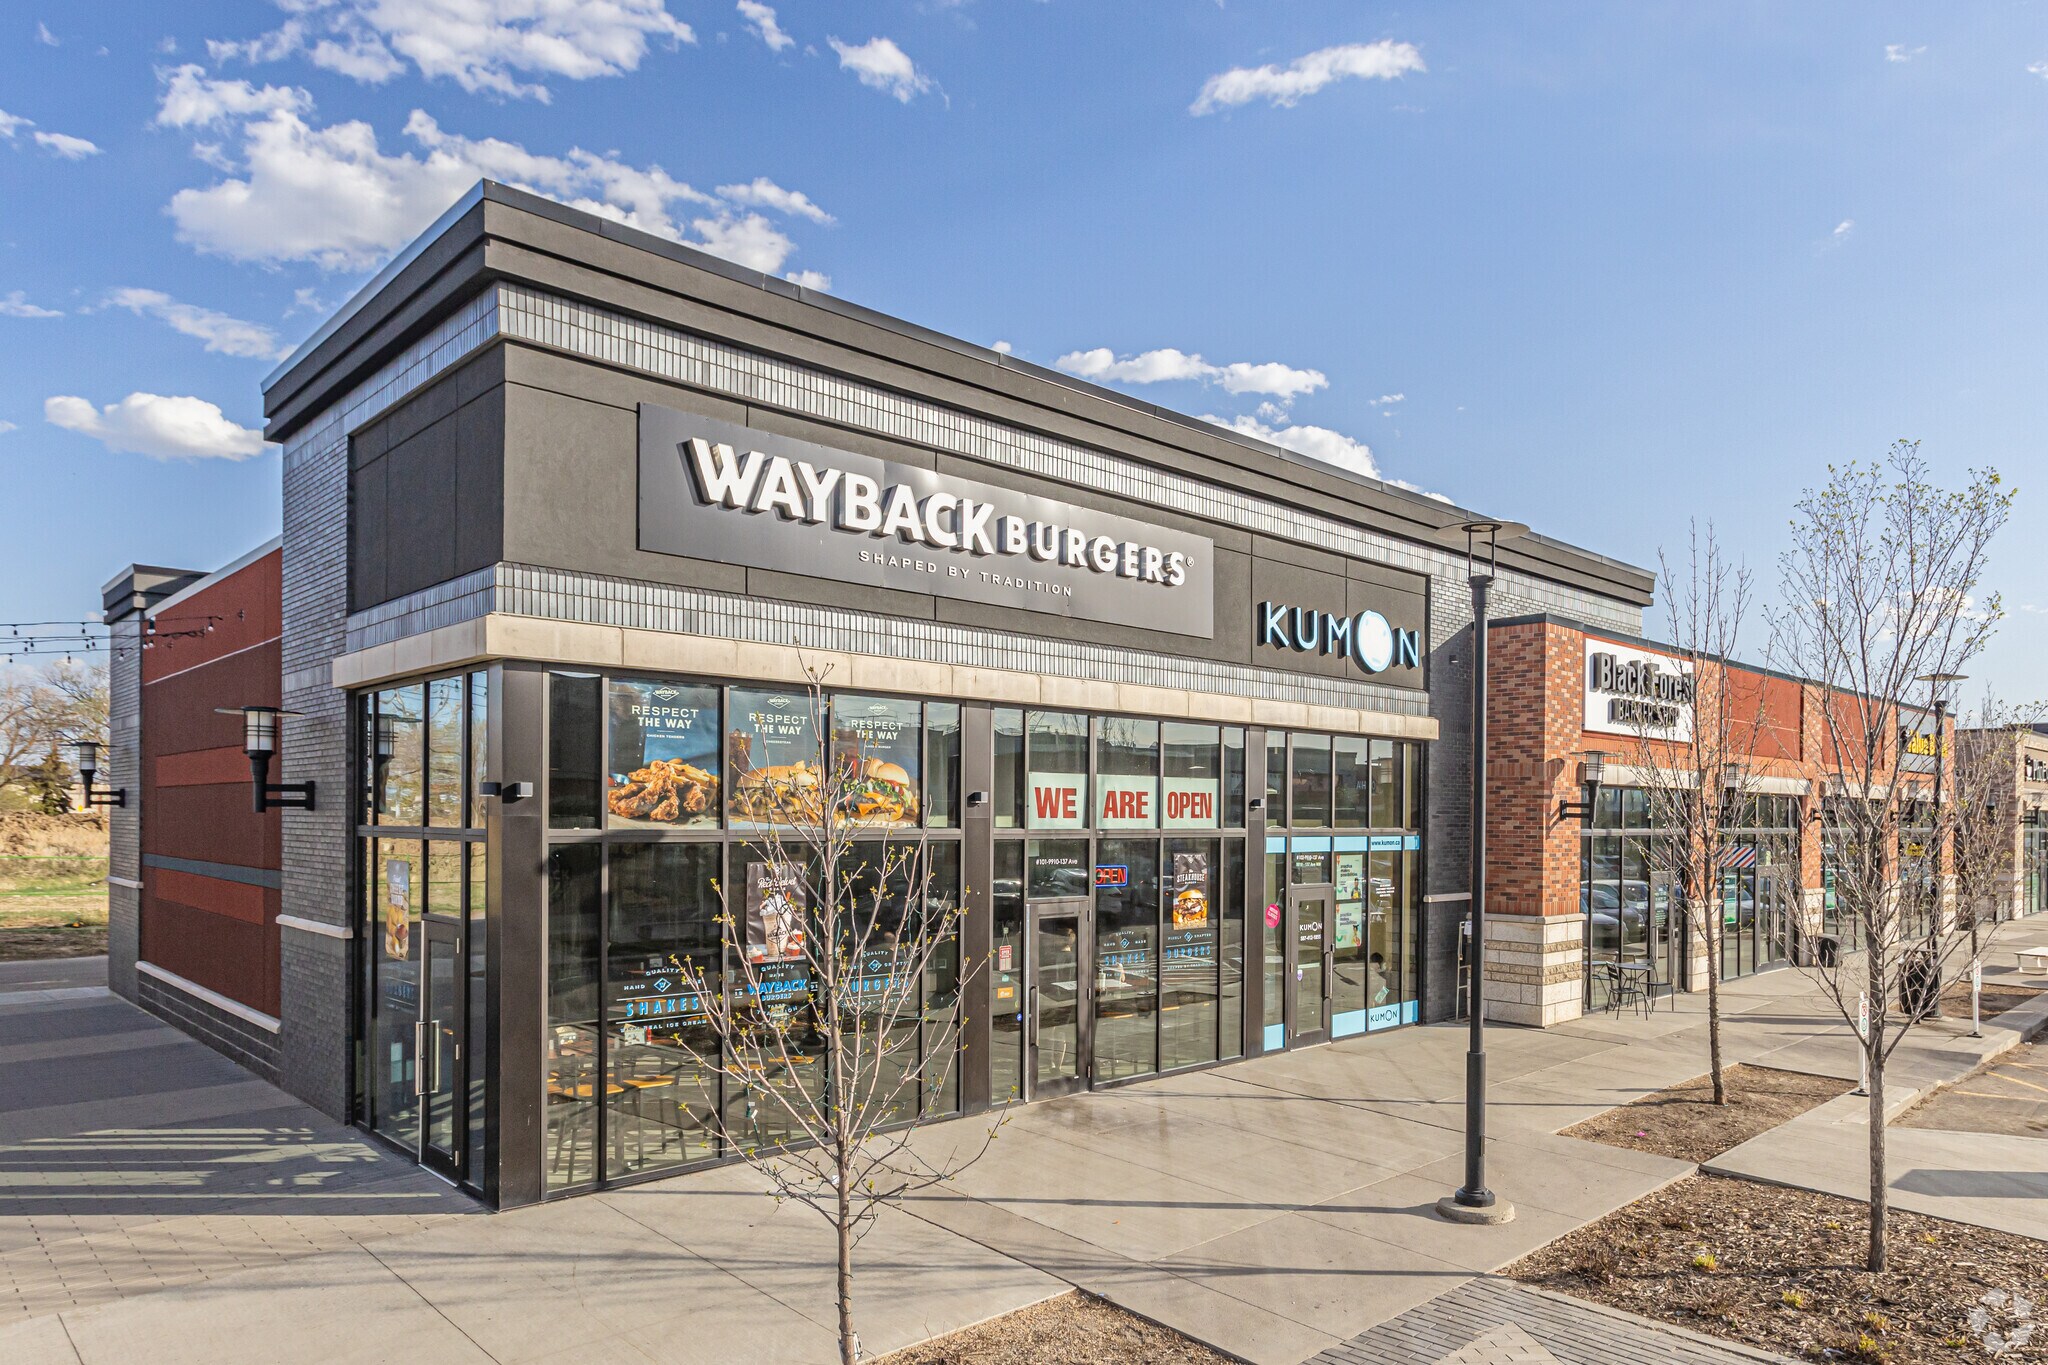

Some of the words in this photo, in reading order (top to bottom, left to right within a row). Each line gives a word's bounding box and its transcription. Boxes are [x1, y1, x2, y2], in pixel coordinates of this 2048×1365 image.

[679, 437, 995, 556] WAYBACK
[859, 550, 937, 573] SHAPED
[948, 566, 970, 579] BY
[980, 571, 1072, 597] TRADITION
[1257, 600, 1420, 675] KUMON
[1593, 652, 1647, 698] Black
[631, 704, 699, 718] RESPECT
[638, 717, 660, 727] THE
[665, 718, 692, 729] WAY
[749, 712, 808, 725] RESPECT
[851, 719, 903, 731] RESPECT
[754, 724, 774, 734] THE
[778, 725, 802, 735] WAY
[877, 730, 898, 740] WAY
[1035, 787, 1077, 818] WE
[1103, 790, 1149, 819] ARE
[1167, 791, 1212, 819] OPEN
[1096, 868, 1126, 884] OPEN
[1177, 873, 1205, 883] STEAKHOUSE
[1299, 921, 1322, 931] KUMON
[1104, 952, 1145, 966] SHAKES
[1167, 945, 1211, 959] BURGERS
[646, 968, 680, 976] QUALITY
[761, 963, 795, 972] QUALITY
[747, 978, 808, 996] WAYBACK
[626, 996, 699, 1017] SHAKES
[1370, 1009, 1398, 1022] KUMON
